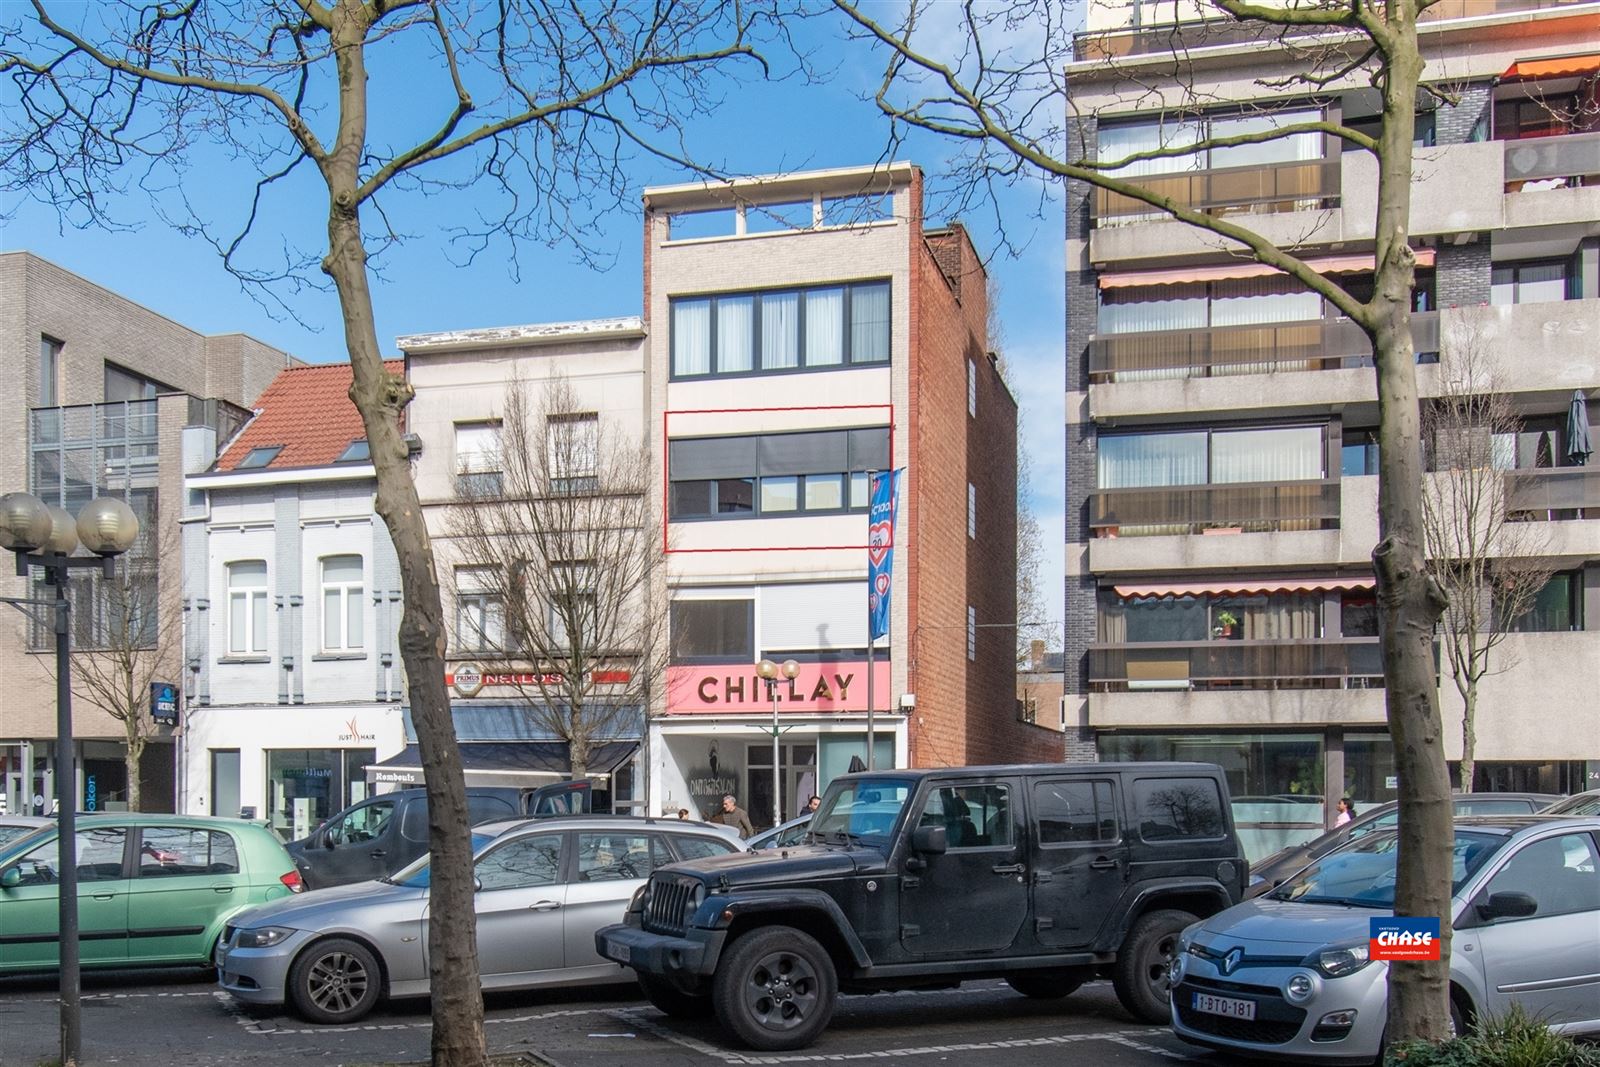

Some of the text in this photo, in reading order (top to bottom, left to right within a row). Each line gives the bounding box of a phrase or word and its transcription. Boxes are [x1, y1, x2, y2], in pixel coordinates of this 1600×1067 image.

[697, 673, 854, 704] CHILLAY
[375, 772, 415, 782] Rombouts
[1588, 771, 1599, 779] 24
[1199, 996, 1251, 1017] 1-BTO-181
